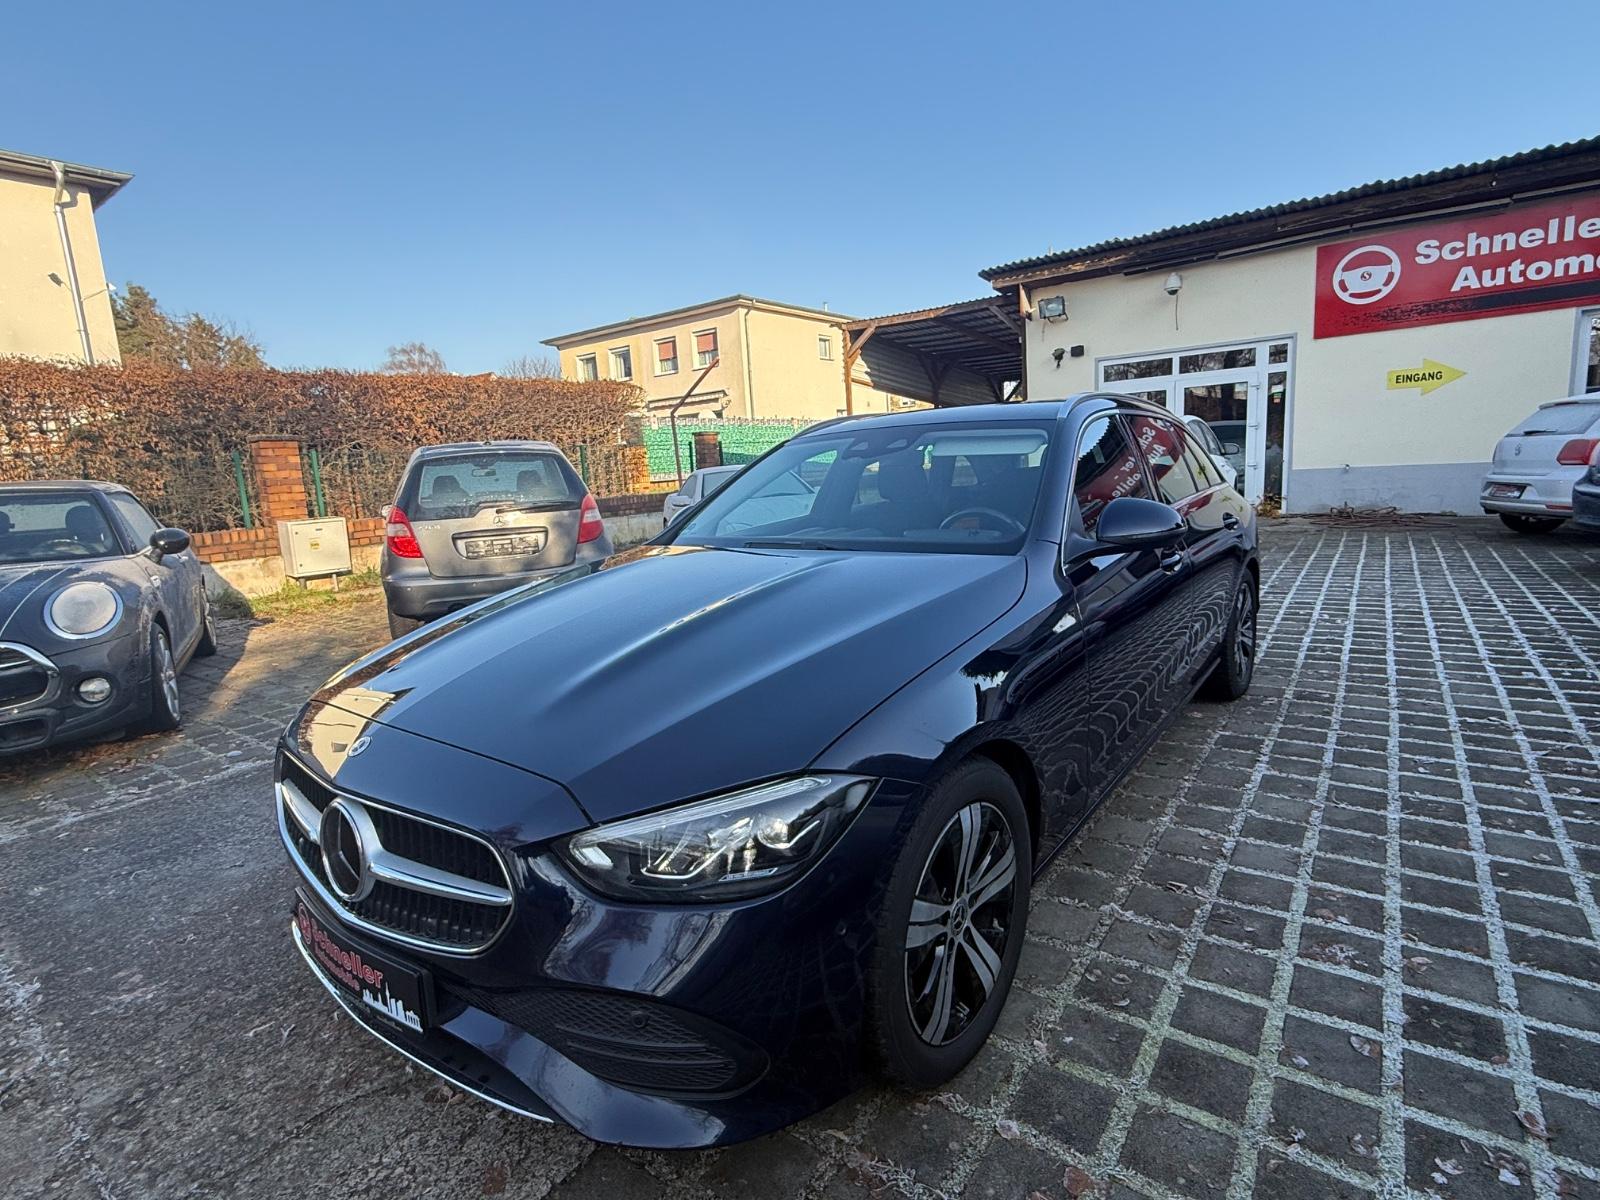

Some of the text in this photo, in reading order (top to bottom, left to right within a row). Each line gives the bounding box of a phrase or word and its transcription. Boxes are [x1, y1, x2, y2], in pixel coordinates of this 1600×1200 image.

[1414, 215, 1600, 265] Schnelle
[1450, 252, 1600, 292] Autom
[1395, 370, 1443, 384] EINGANG
